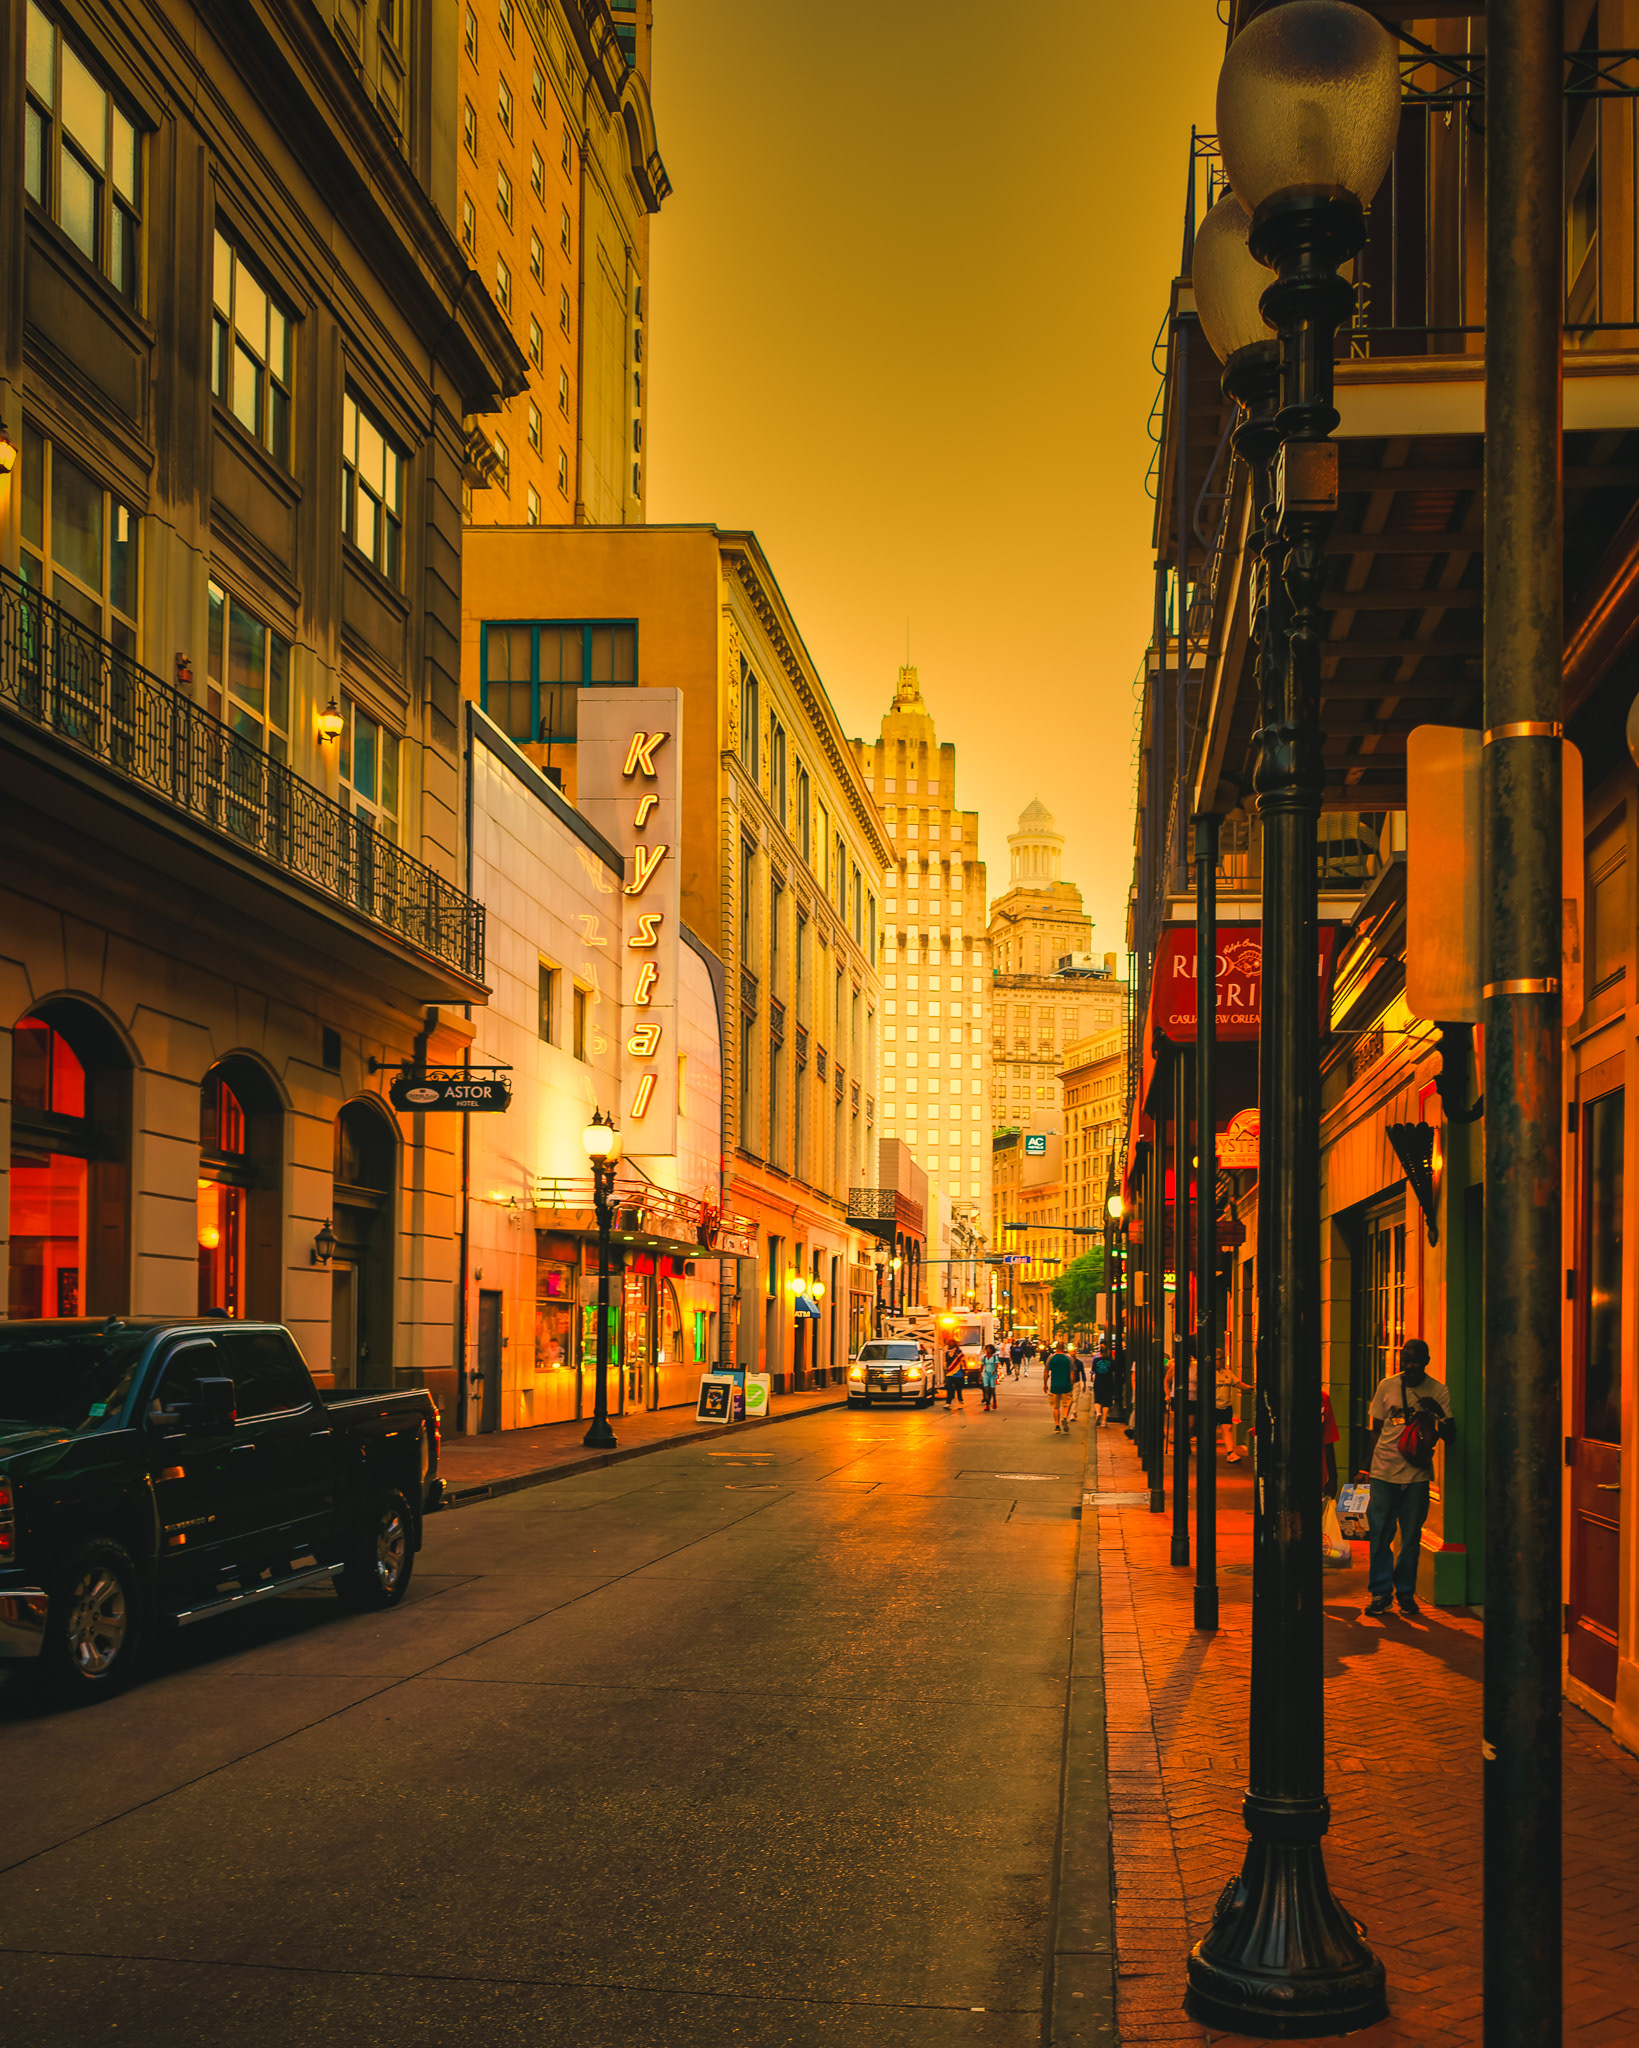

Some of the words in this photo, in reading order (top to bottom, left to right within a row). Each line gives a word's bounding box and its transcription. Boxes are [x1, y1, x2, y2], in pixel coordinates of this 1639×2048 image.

[622, 732, 671, 1118] Krystal
[444, 1086, 492, 1098] ASTOR
[1028, 1137, 1044, 1145] AC
